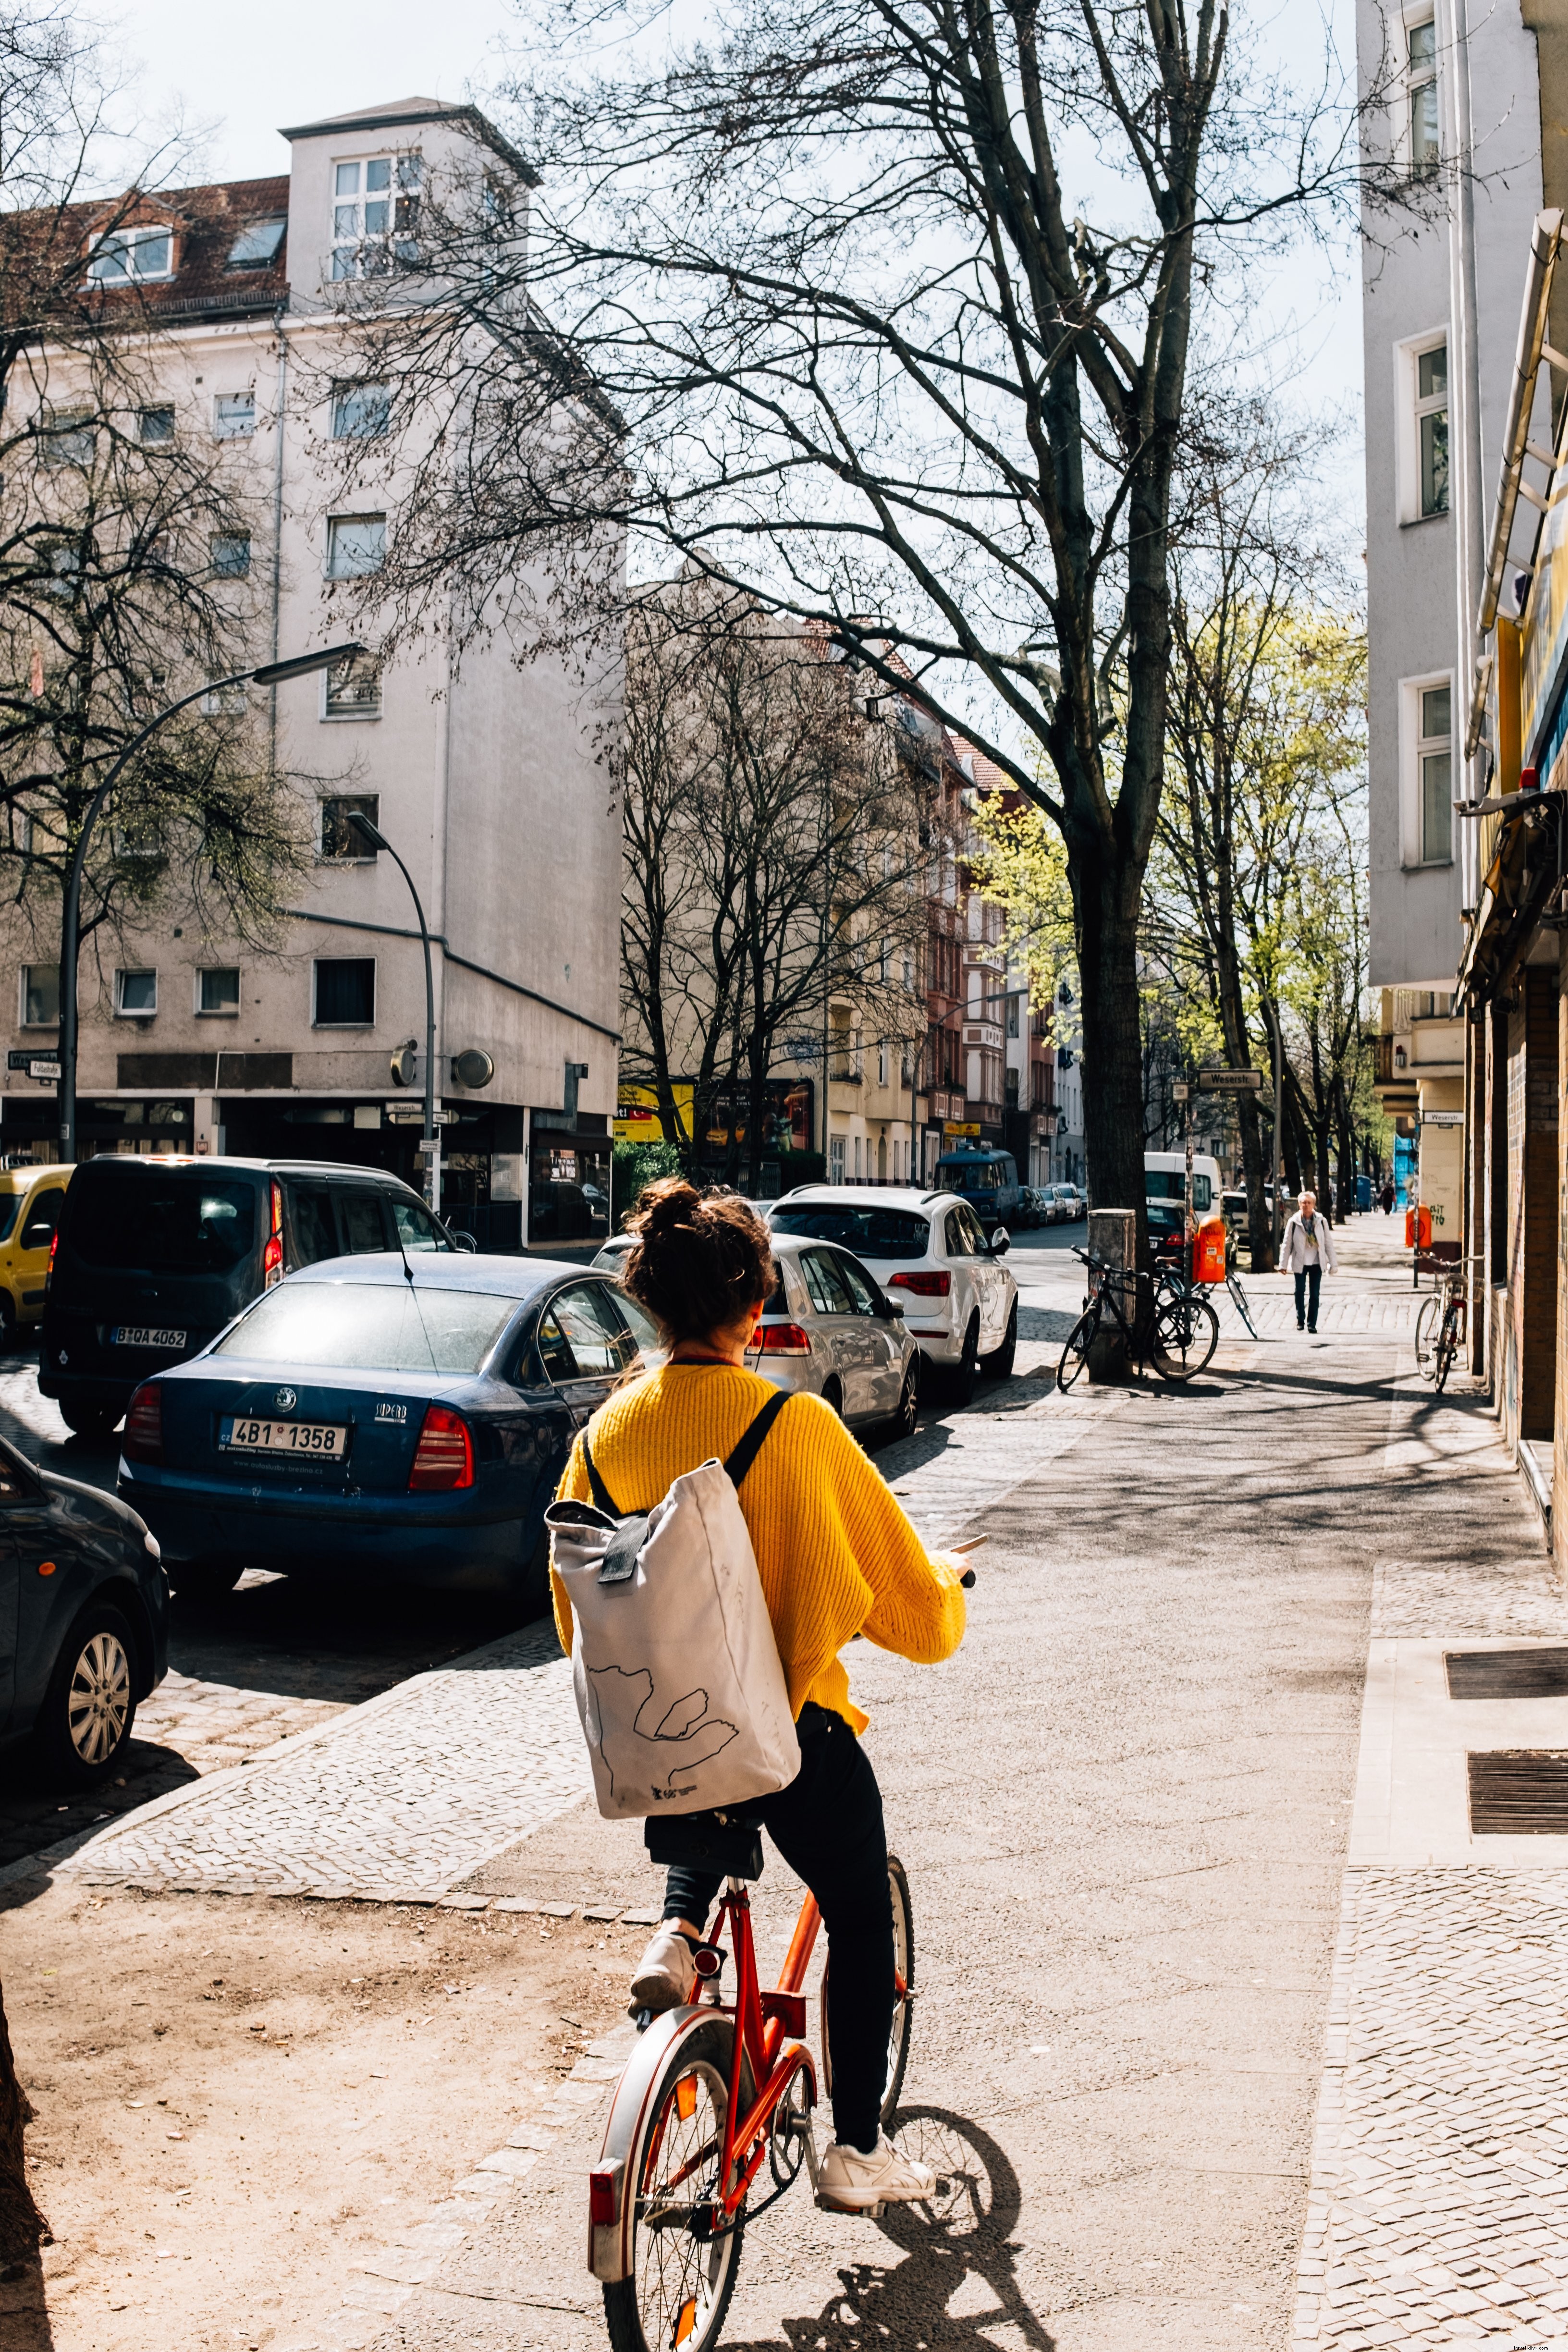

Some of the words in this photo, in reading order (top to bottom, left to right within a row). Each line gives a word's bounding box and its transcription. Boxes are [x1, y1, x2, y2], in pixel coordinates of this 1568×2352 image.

[1212, 1074, 1249, 1084] Weserstr.
[117, 1328, 126, 1342] B
[134, 1330, 149, 1344] QA
[152, 1331, 185, 1346] 4062
[375, 1403, 407, 1419] SUPERB
[236, 1421, 272, 1445] 4B1
[289, 1425, 336, 1450] 1358
